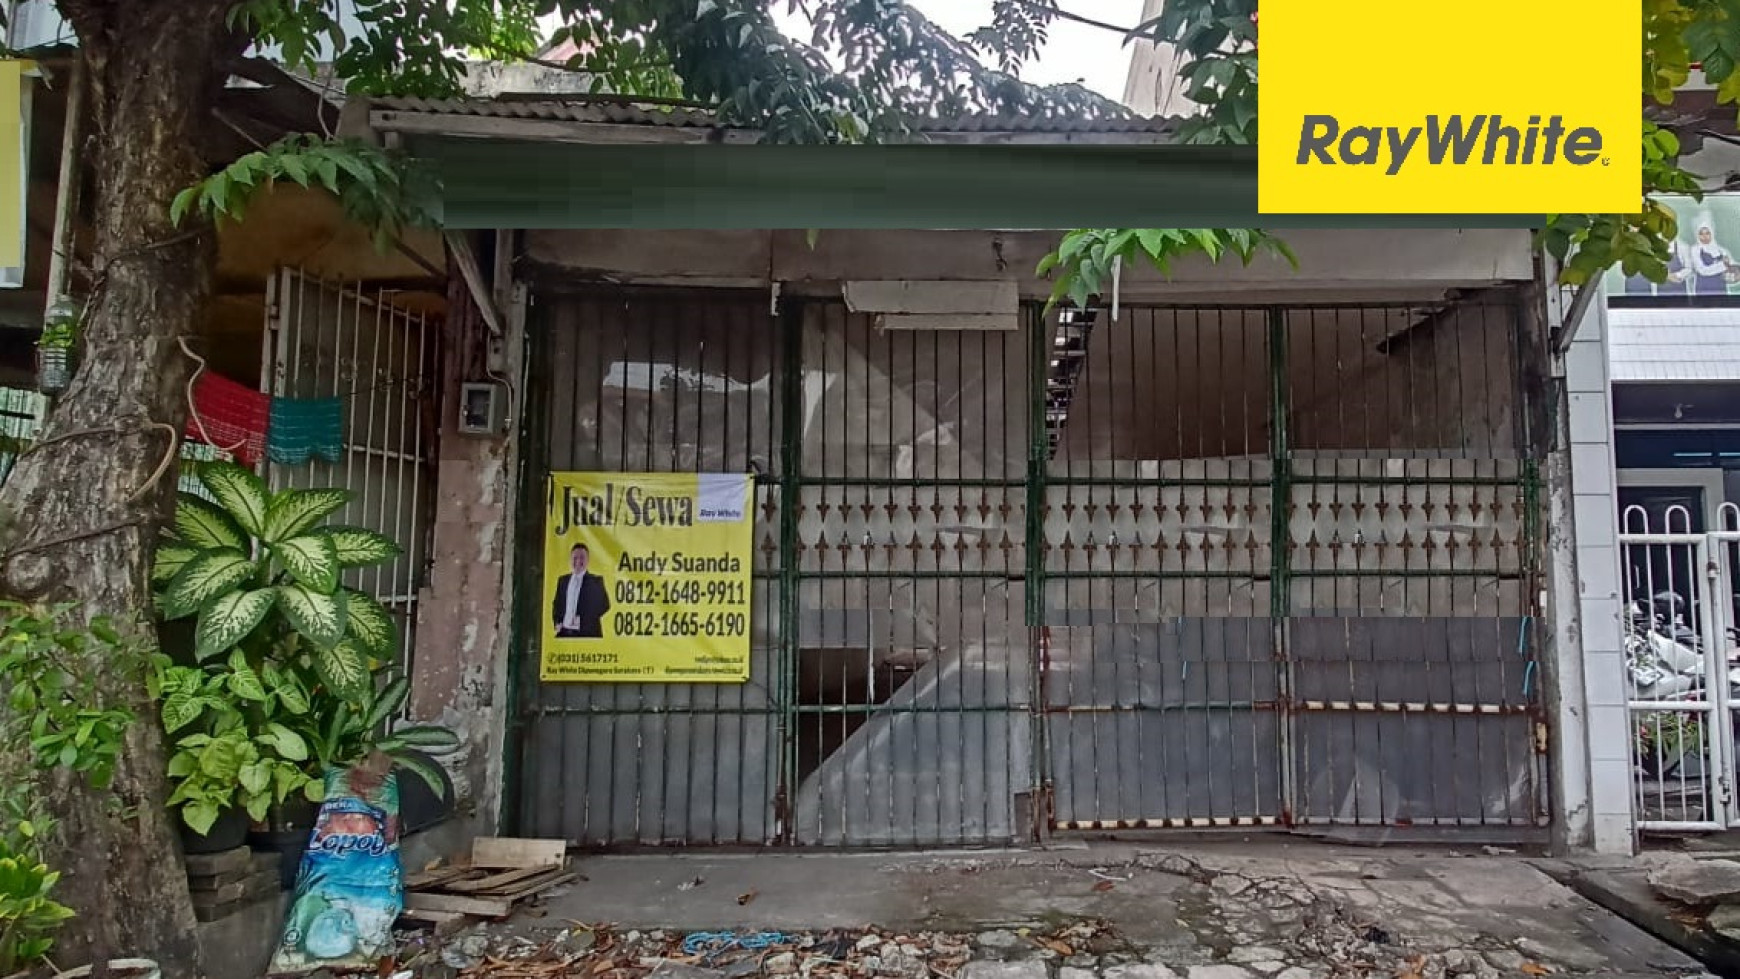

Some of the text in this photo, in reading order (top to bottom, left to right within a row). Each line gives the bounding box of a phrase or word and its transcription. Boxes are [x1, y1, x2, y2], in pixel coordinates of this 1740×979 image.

[555, 483, 693, 535] Jual/Sewa
[617, 551, 740, 575] Andy Suanda
[614, 579, 745, 605] 0812-1648-9911
[613, 611, 745, 637] 0812-1665-6190
